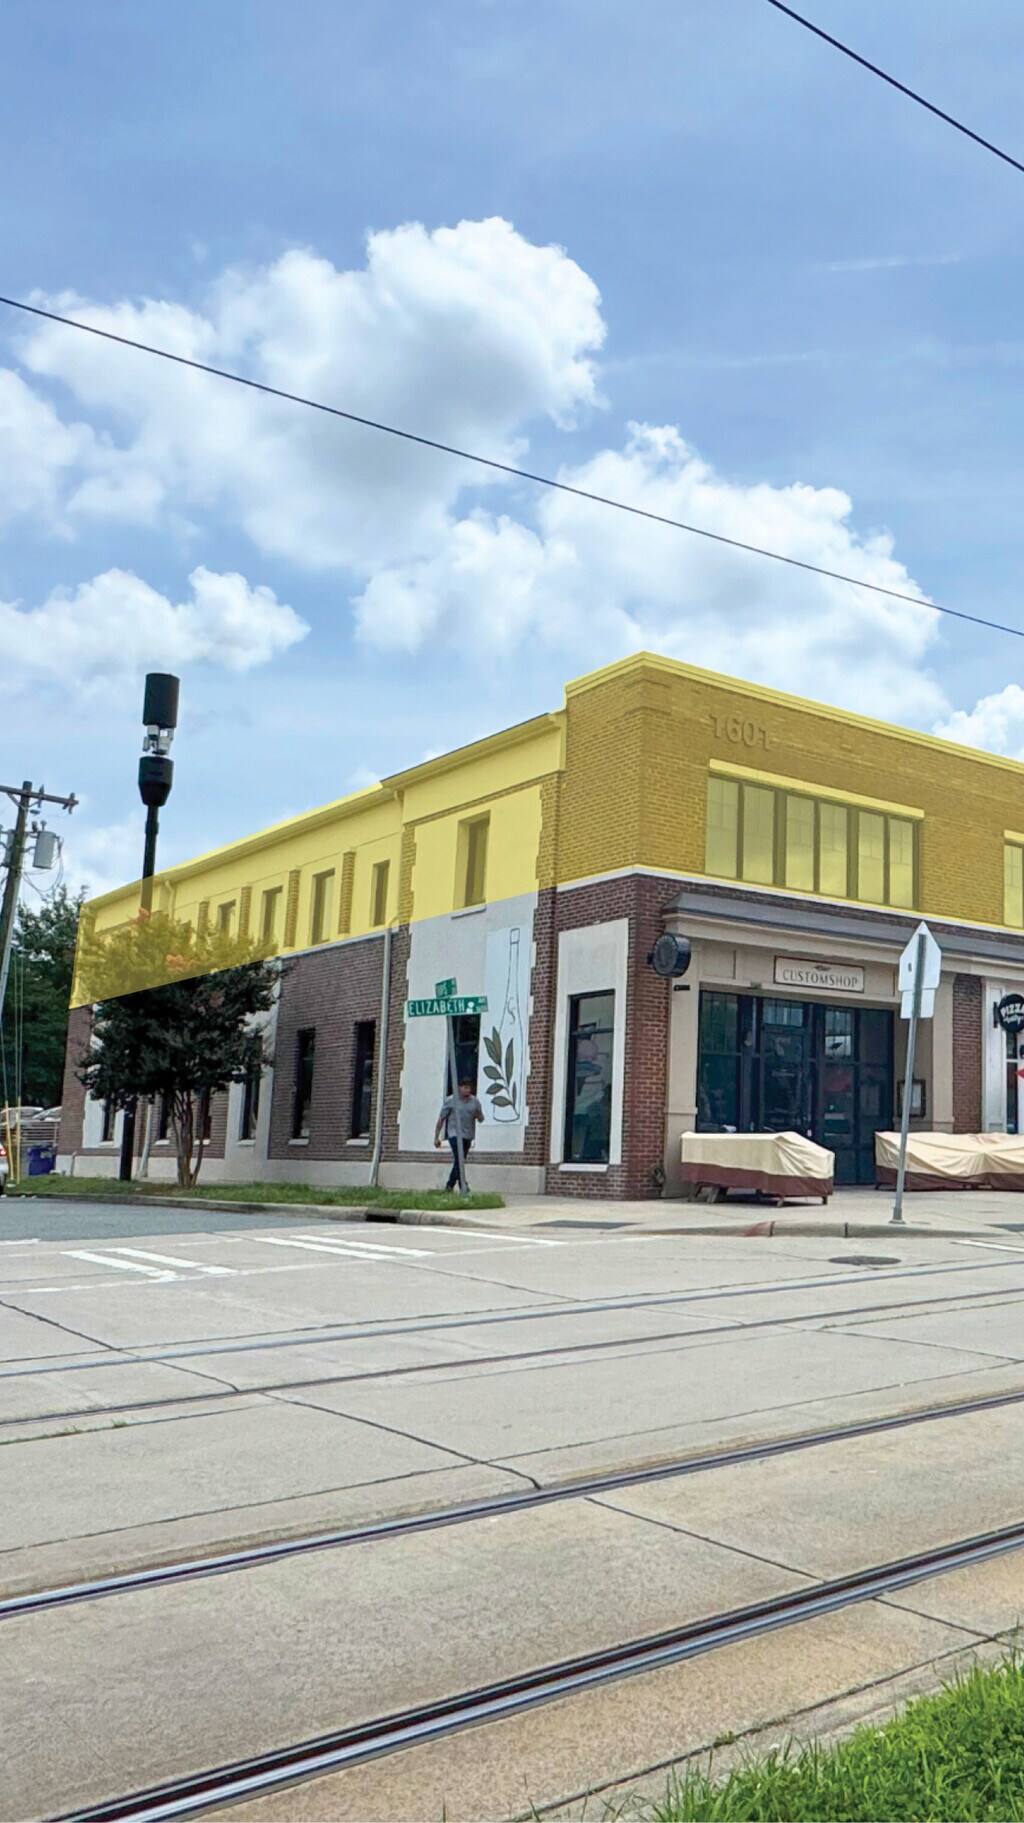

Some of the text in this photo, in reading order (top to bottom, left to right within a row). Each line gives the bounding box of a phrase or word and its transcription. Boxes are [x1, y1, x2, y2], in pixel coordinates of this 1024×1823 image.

[708, 711, 771, 753] 1601
[782, 969, 858, 988] CUSTOMSHOP
[408, 999, 465, 1016] ELIZABETH
